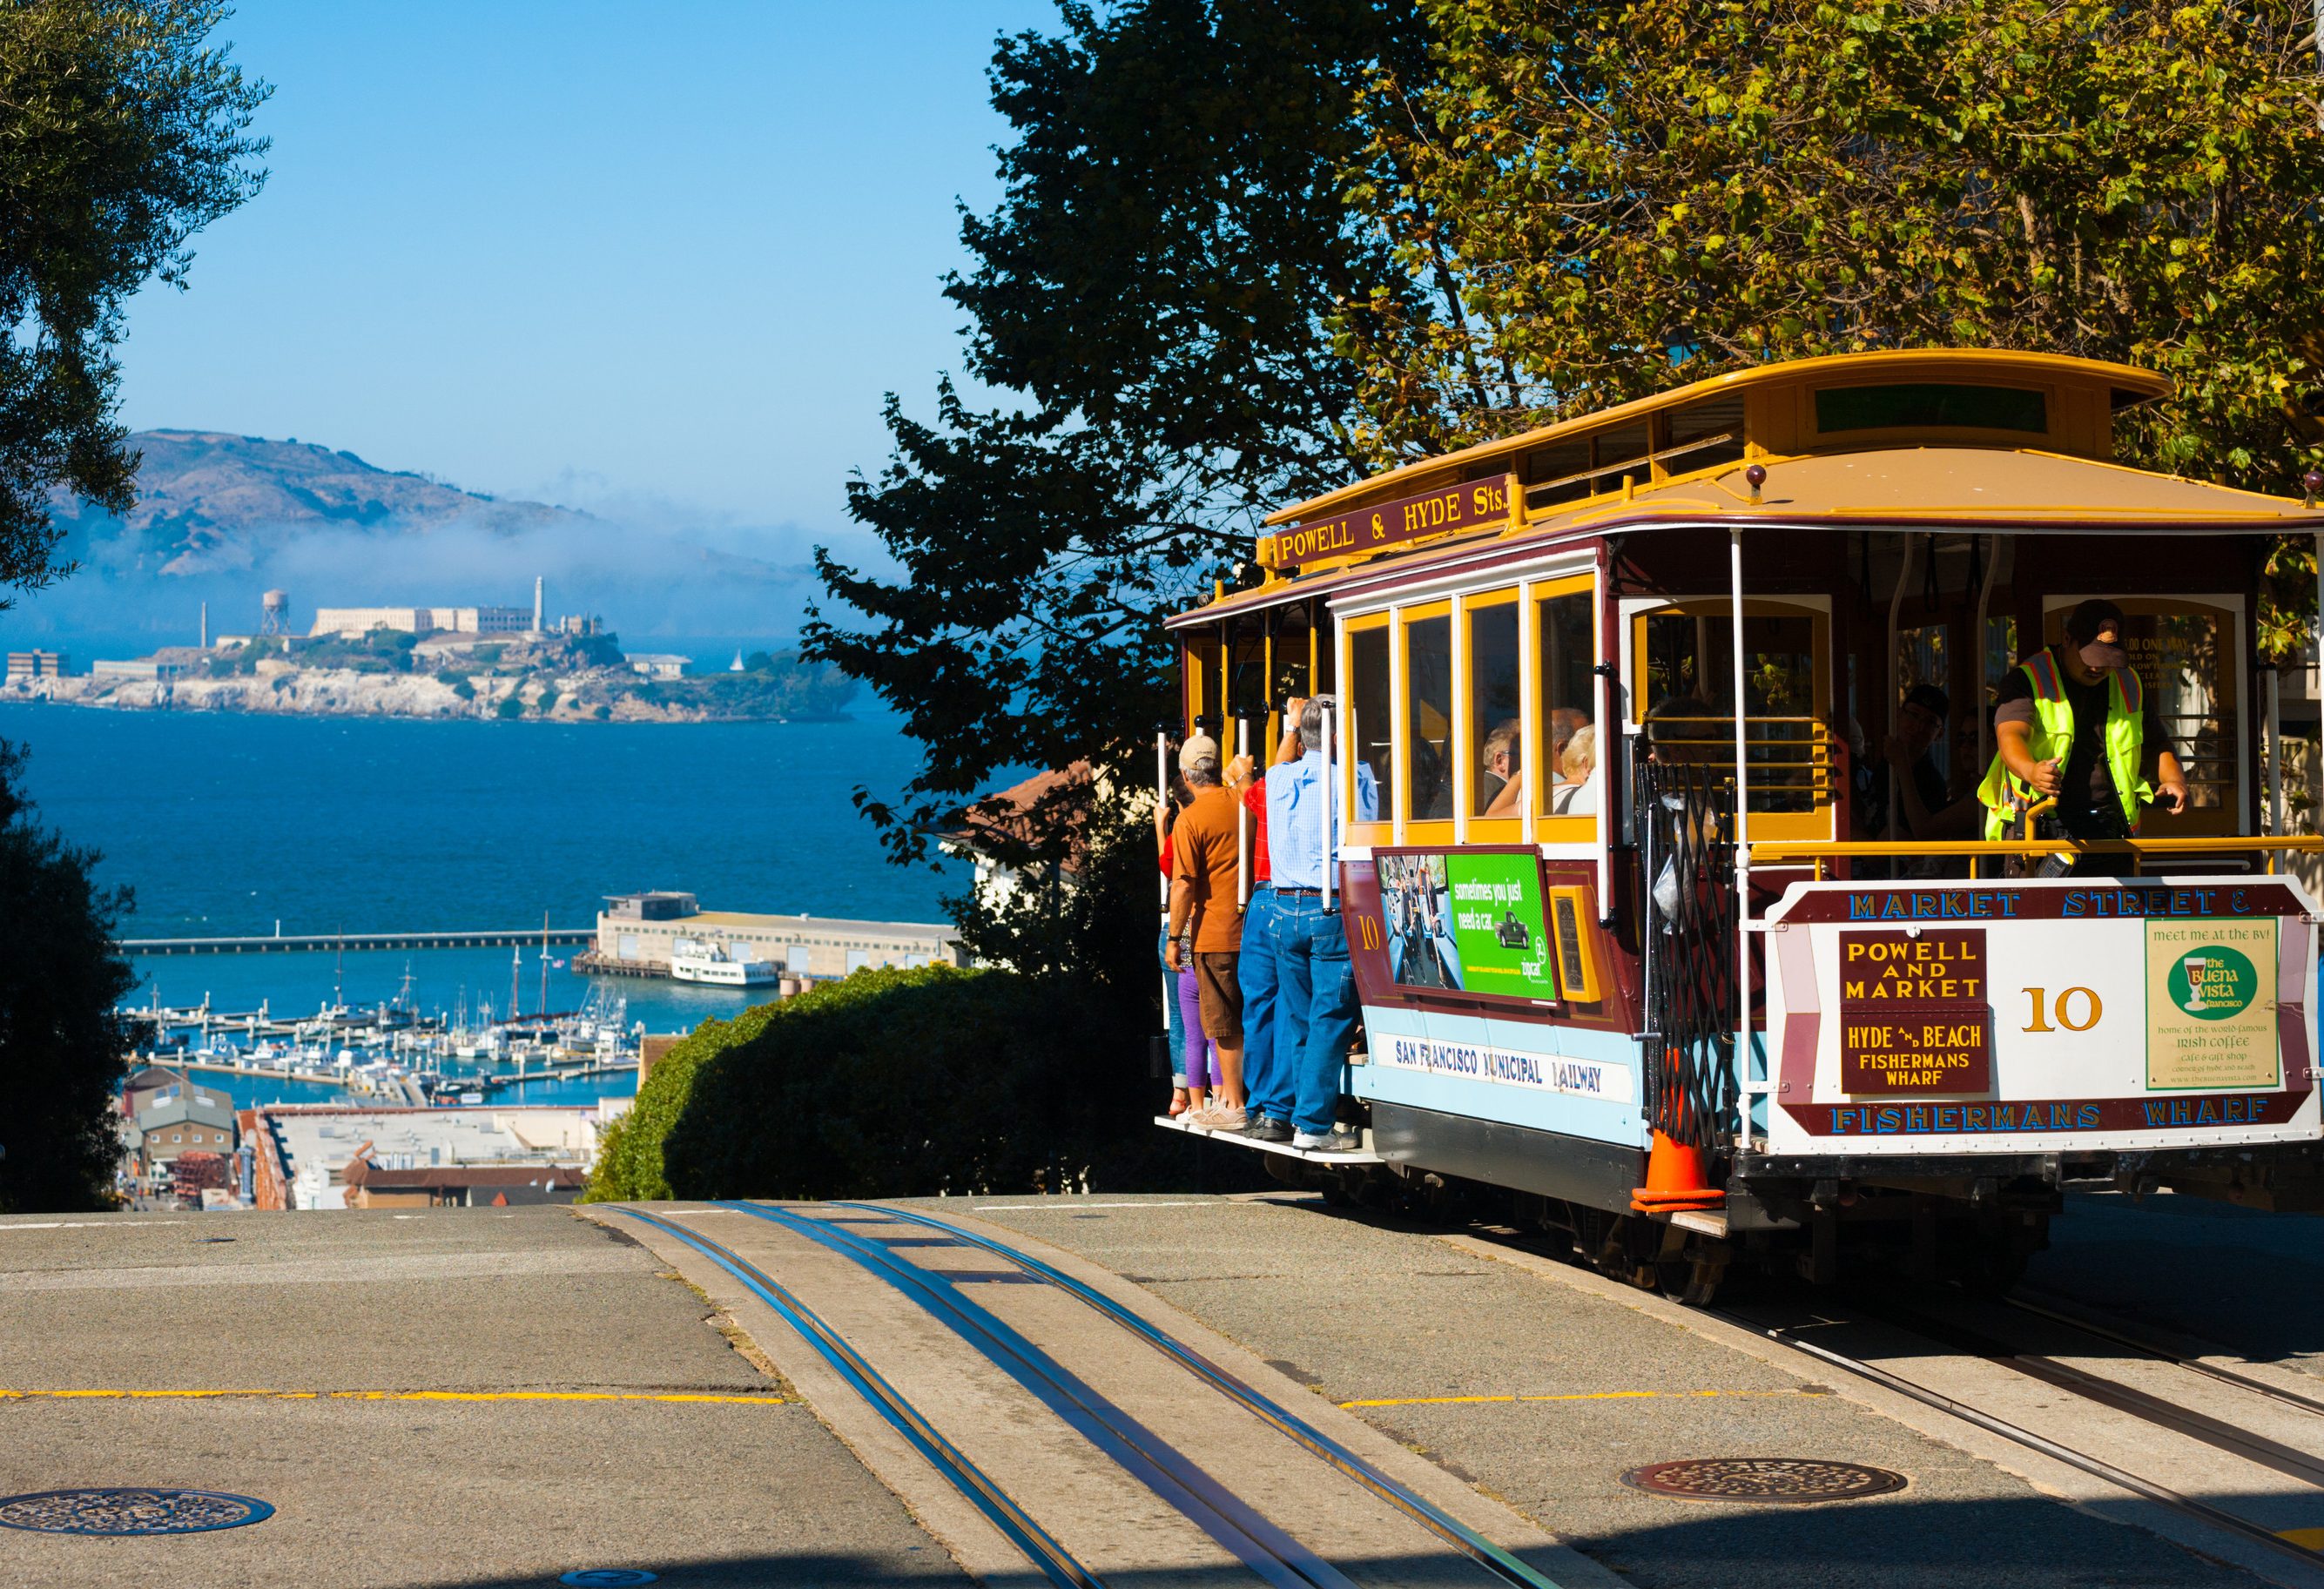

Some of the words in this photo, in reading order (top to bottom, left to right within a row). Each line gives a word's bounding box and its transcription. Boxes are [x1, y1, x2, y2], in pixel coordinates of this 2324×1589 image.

[1281, 522, 1355, 560] POWELL
[1371, 513, 1385, 540] &
[1404, 493, 1461, 532] HYDE
[1473, 485, 1509, 515] Sts.
[1454, 878, 1492, 900] sometimes
[1492, 883, 1506, 906] you
[1506, 878, 1522, 907] just
[1849, 892, 2020, 919] MARKET
[2062, 889, 2215, 917] STREET
[2232, 888, 2250, 913] &
[1458, 907, 1475, 930] need
[1475, 913, 1480, 930] a
[1480, 913, 1494, 931] car.
[1358, 915, 1379, 950] 10
[2153, 930, 2186, 940] meet
[2190, 930, 2209, 940] me
[2213, 929, 2225, 940] at
[2229, 928, 2249, 940] the
[2253, 929, 2270, 939] BV!
[1847, 941, 1977, 962] POWELL
[2206, 958, 2224, 968] the
[1521, 957, 1541, 980] zipcar
[1882, 963, 1947, 978] AND
[1845, 979, 1980, 1000] MARKET
[2021, 986, 2103, 1032] 10
[1848, 1026, 1893, 1048] HYDE
[1897, 1027, 1919, 1047] AND
[1923, 1025, 1981, 1047] BEACH
[2158, 1026, 2180, 1034] home
[2183, 1026, 2193, 1035] of
[2195, 1025, 2208, 1034] the
[1396, 1040, 1417, 1065] SAN
[1419, 1043, 1477, 1074] FRANCISCO
[1860, 1054, 1970, 1069] FISHERMANS
[2226, 1052, 2247, 1061] shop
[1886, 1071, 1943, 1086] WHARF
[1830, 1102, 2101, 1134] FISHERMANS
[2143, 1096, 2269, 1127] WHARF
